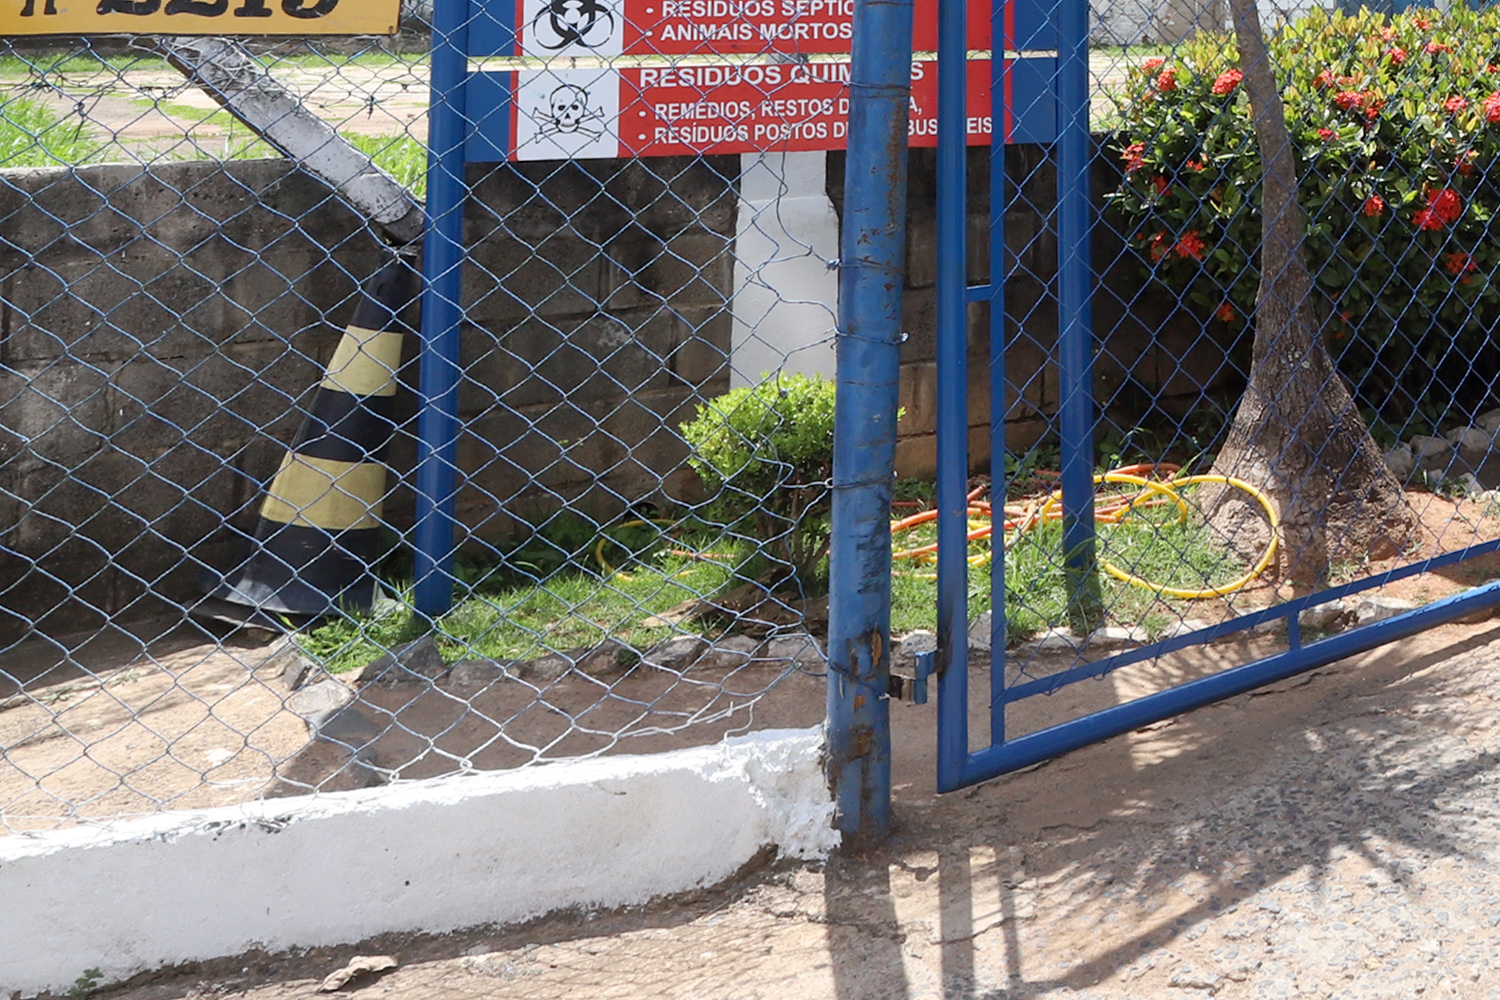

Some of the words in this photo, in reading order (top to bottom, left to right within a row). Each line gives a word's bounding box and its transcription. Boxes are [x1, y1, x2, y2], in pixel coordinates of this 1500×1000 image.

[660, 22, 753, 41] ANIMAIS
[759, 22, 853, 40] MORTOS
[639, 65, 782, 88] RESIDUOS
[761, 98, 833, 117] RESTOS
[654, 121, 749, 144] RESÍDUOS
[754, 121, 827, 141] POSTOS
